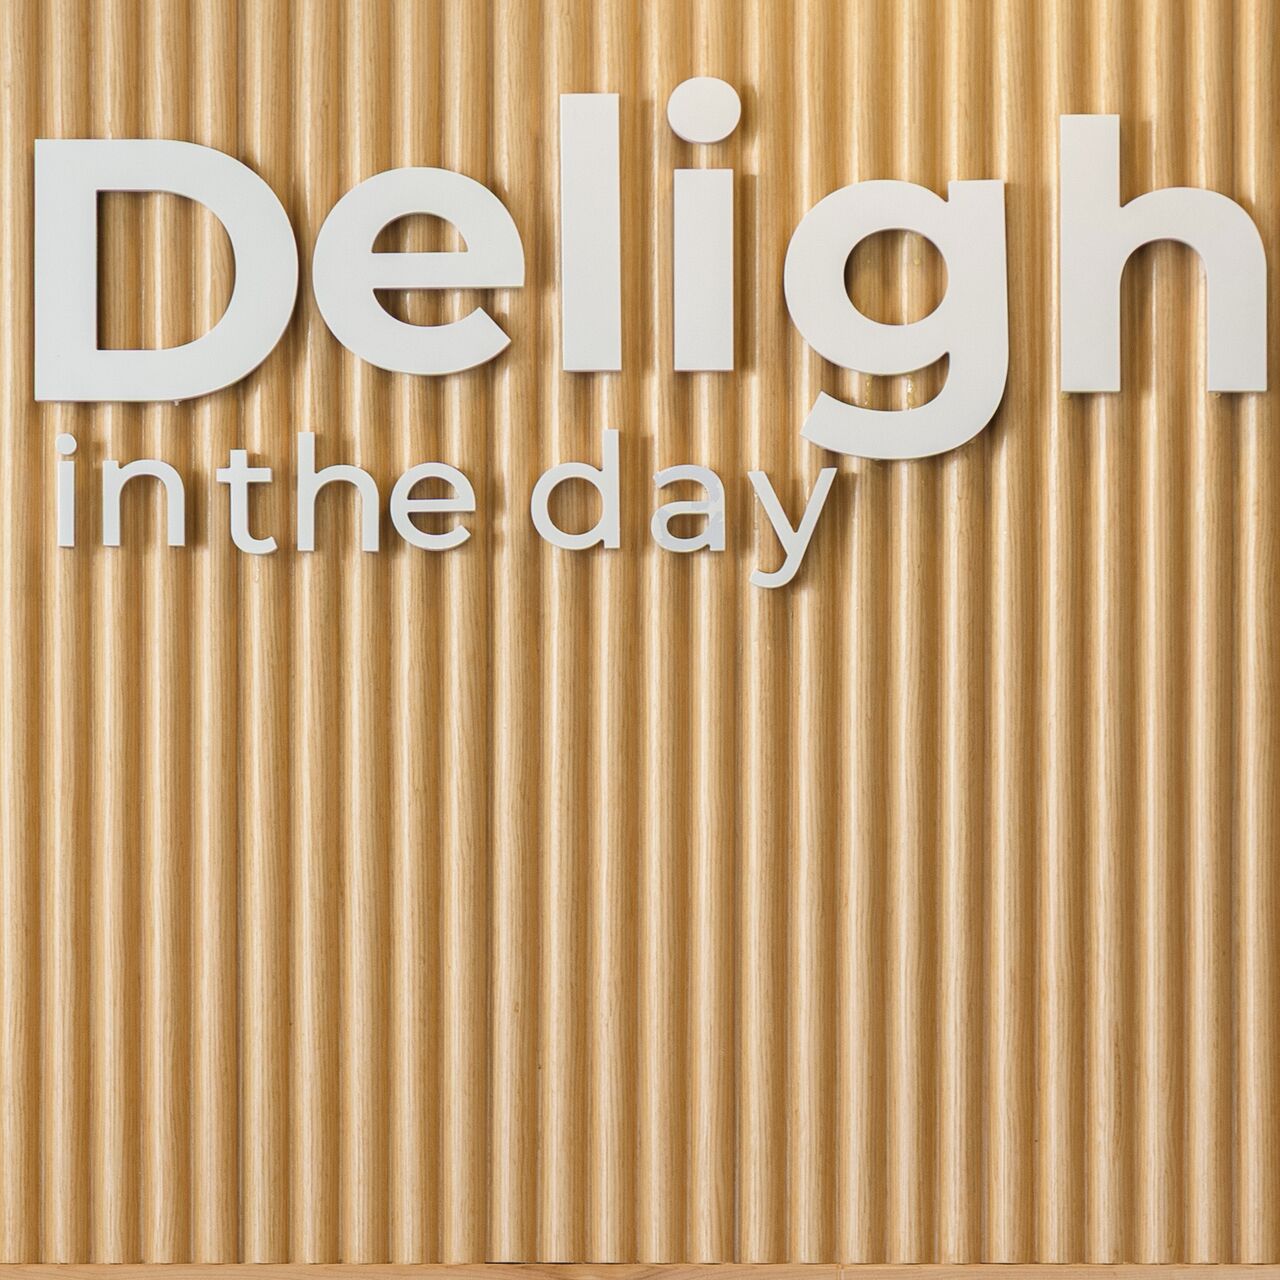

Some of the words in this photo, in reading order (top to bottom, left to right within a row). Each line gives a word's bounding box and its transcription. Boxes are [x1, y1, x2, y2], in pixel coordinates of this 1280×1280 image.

[55, 432, 185, 548] in
[217, 430, 476, 555] the
[530, 428, 838, 588] day
